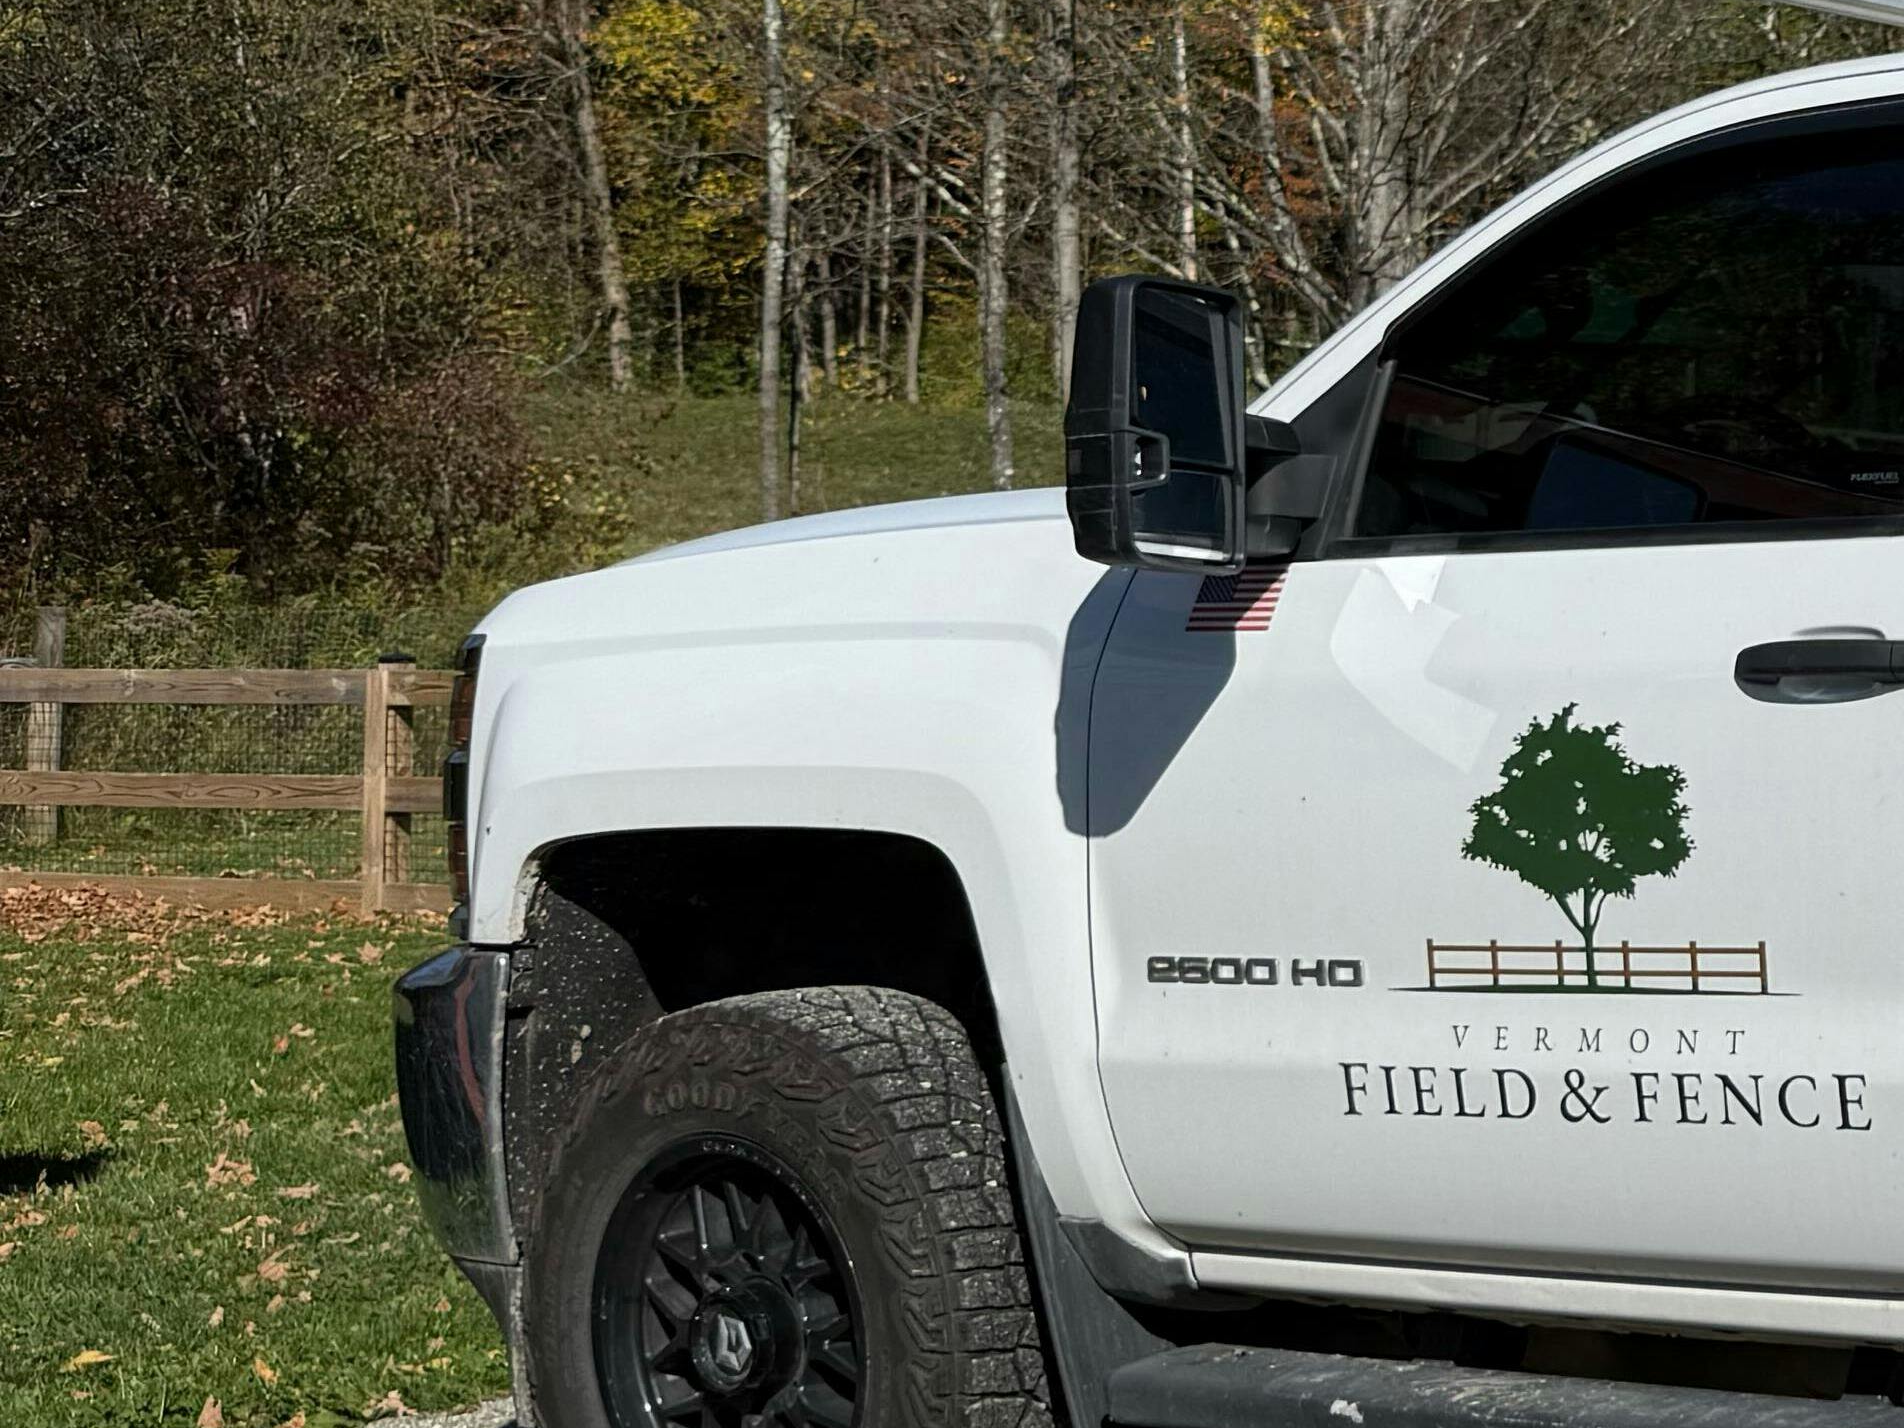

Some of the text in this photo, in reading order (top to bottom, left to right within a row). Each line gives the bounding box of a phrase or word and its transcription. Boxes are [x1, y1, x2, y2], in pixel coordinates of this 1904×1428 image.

[1147, 956, 1363, 987] 2500 HD
[1452, 1025, 1746, 1055] VERMONT
[1338, 1062, 1874, 1131] FIELD & FENCE
